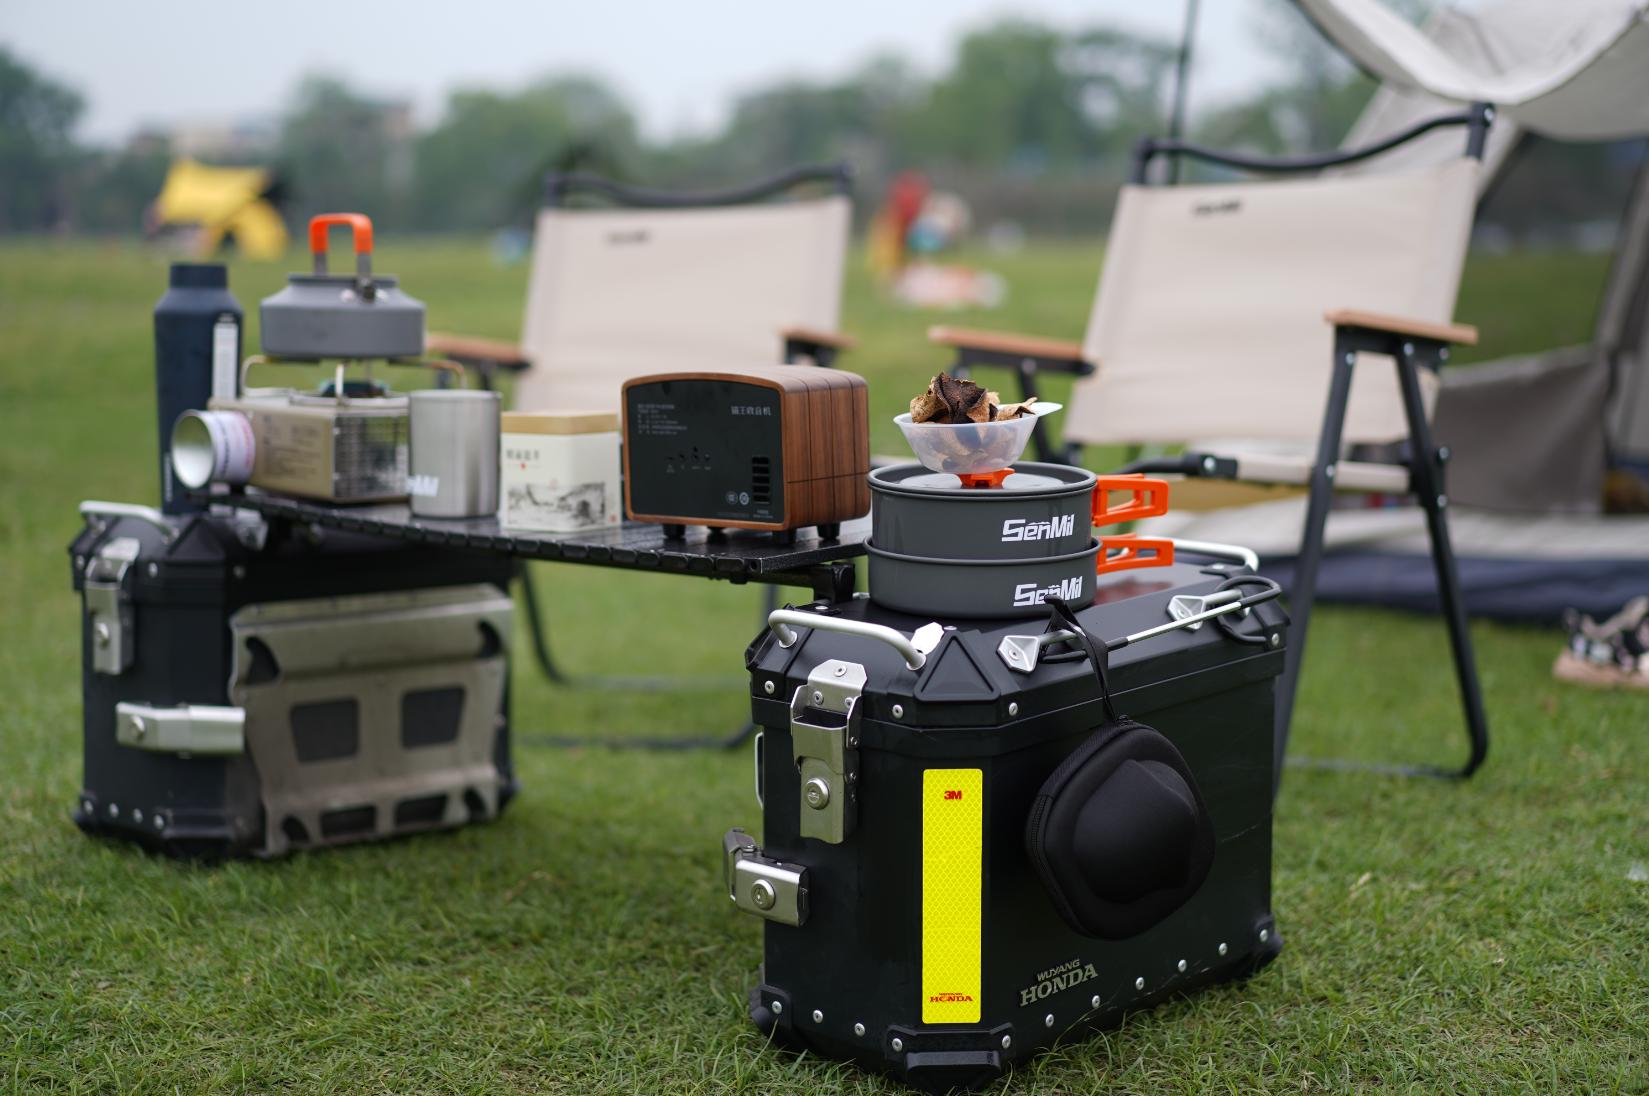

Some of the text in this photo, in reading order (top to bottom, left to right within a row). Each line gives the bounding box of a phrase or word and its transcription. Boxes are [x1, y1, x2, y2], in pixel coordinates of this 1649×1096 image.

[1001, 514, 1075, 542] SenMil
[944, 790, 962, 800] 3M
[1037, 959, 1080, 982] WUYANG
[1020, 963, 1098, 1007] HONDA
